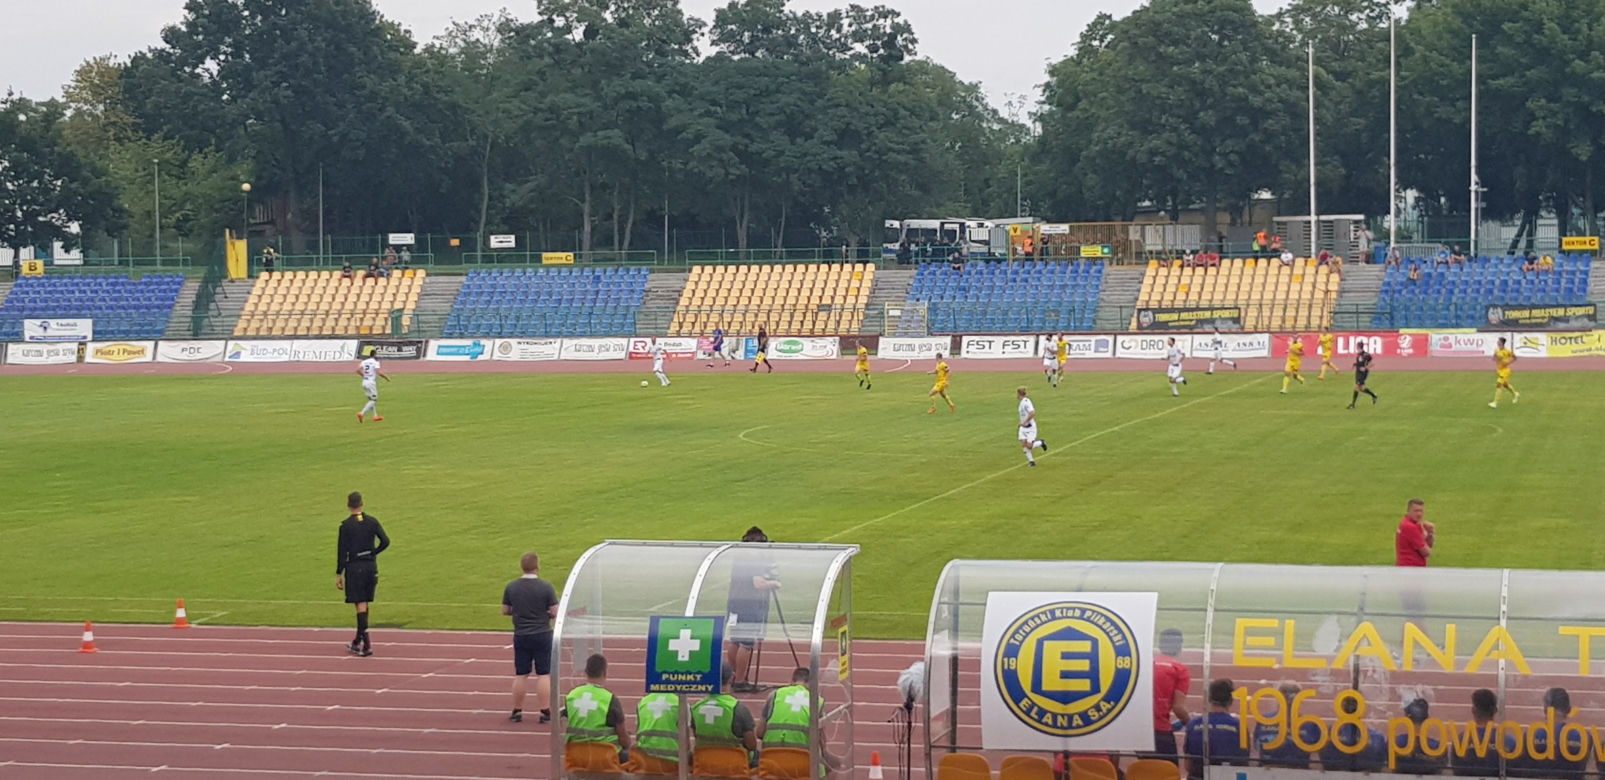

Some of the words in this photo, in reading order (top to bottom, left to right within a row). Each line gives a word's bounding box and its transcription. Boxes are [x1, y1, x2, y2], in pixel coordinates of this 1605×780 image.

[1588, 238, 1596, 247] C
[565, 254, 572, 262] C
[28, 261, 38, 271] B
[966, 339, 995, 350] FST
[1002, 339, 1030, 350] FST
[1337, 335, 1384, 354] LIGA
[1454, 335, 1484, 347] kwp
[1550, 334, 1587, 346] HOTEL
[1054, 608, 1082, 619] Klub
[1233, 617, 1532, 676] ELANA
[1003, 657, 1018, 670] 19
[1041, 640, 1092, 692] E
[1115, 656, 1132, 669] 68
[661, 673, 703, 682] PUNKT
[649, 683, 714, 693] MEDYCZNY
[1018, 697, 1084, 728] ELANA
[1087, 700, 1116, 722] S.A.
[1231, 686, 1369, 755] 1968
